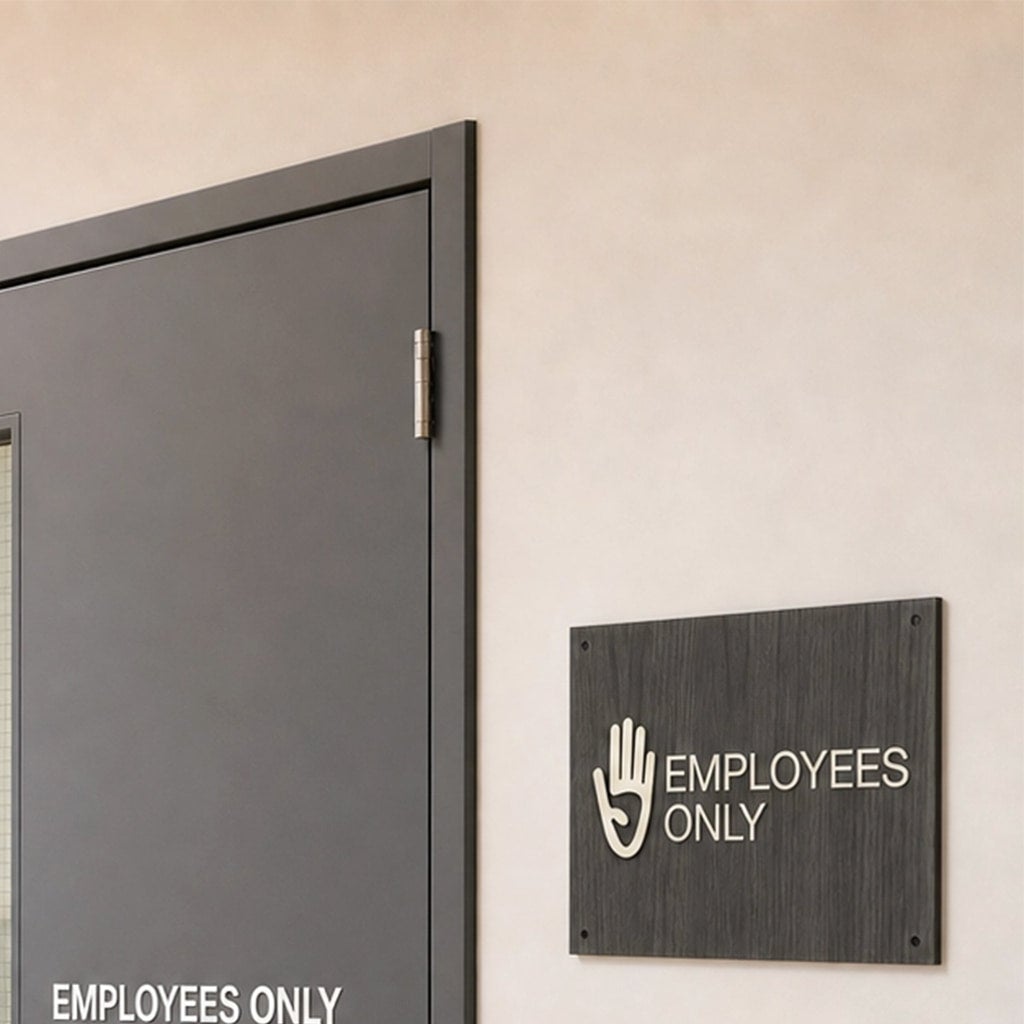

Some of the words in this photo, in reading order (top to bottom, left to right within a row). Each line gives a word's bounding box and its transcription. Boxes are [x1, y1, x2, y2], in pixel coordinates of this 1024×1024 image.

[665, 746, 910, 793] EMPLOYEES
[663, 802, 767, 843] ONLY
[51, 982, 241, 1024] EMPLOYEES
